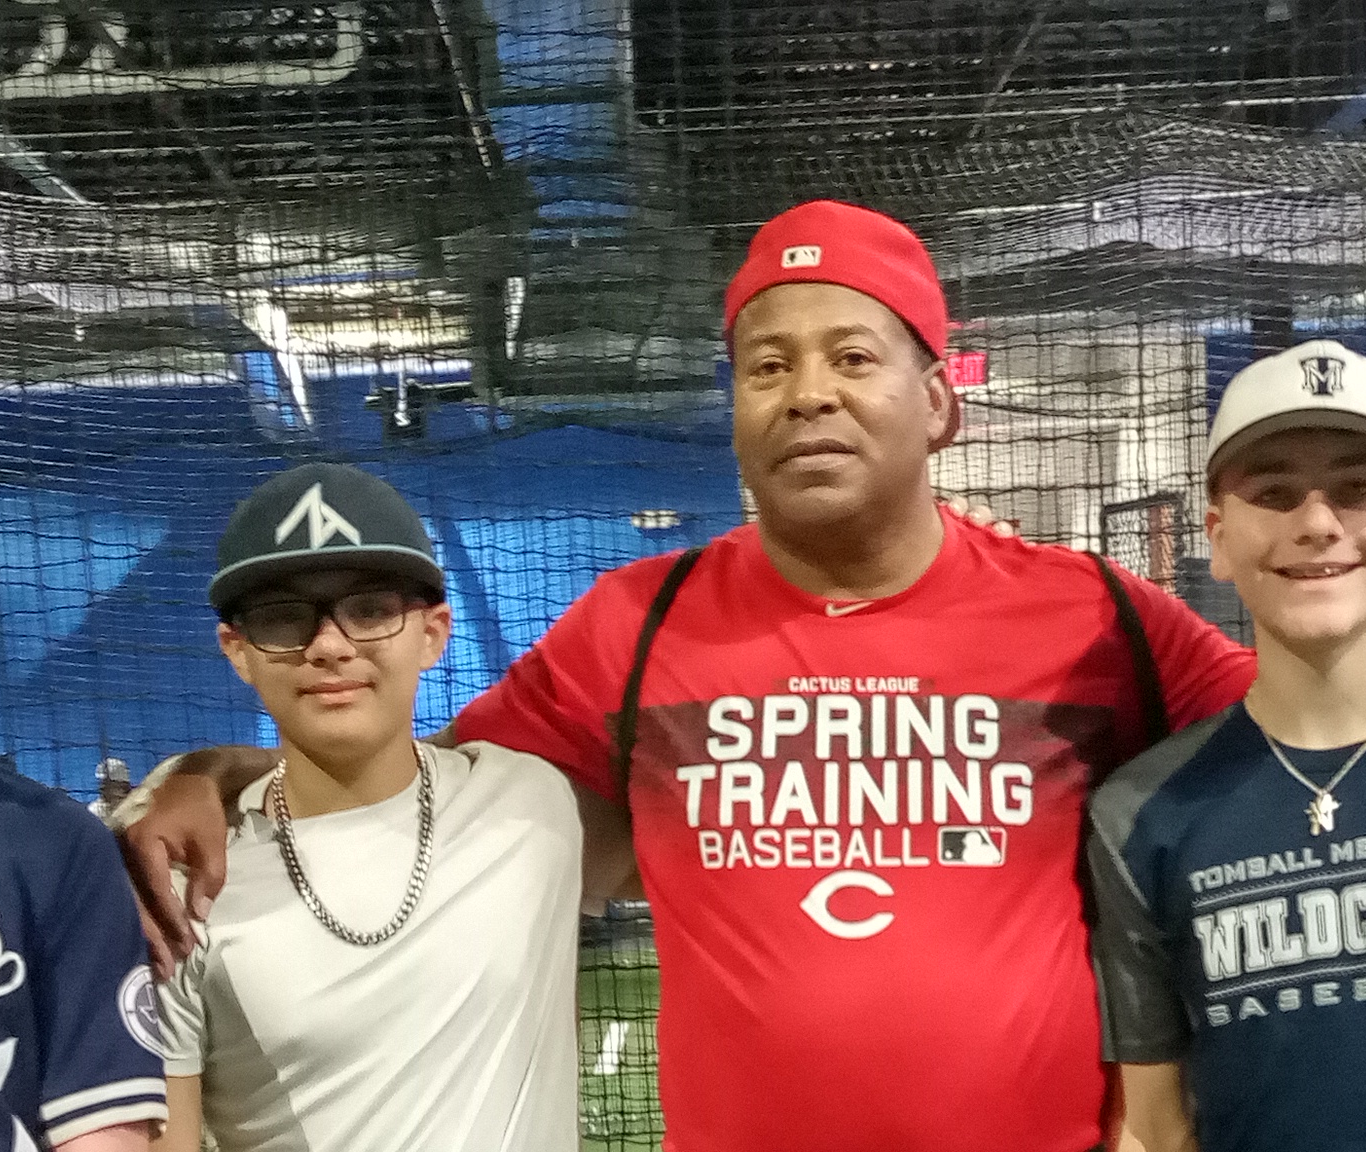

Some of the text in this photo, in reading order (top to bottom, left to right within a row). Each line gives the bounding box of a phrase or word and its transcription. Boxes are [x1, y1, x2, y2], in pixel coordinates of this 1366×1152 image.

[788, 676, 919, 693] CACTUS LEAGUE
[706, 694, 1001, 762] SPRING
[676, 759, 1034, 828] TRAINING
[698, 827, 930, 869] BASEBALL
[1188, 847, 1325, 892] TOMBALL
[799, 869, 895, 940] C
